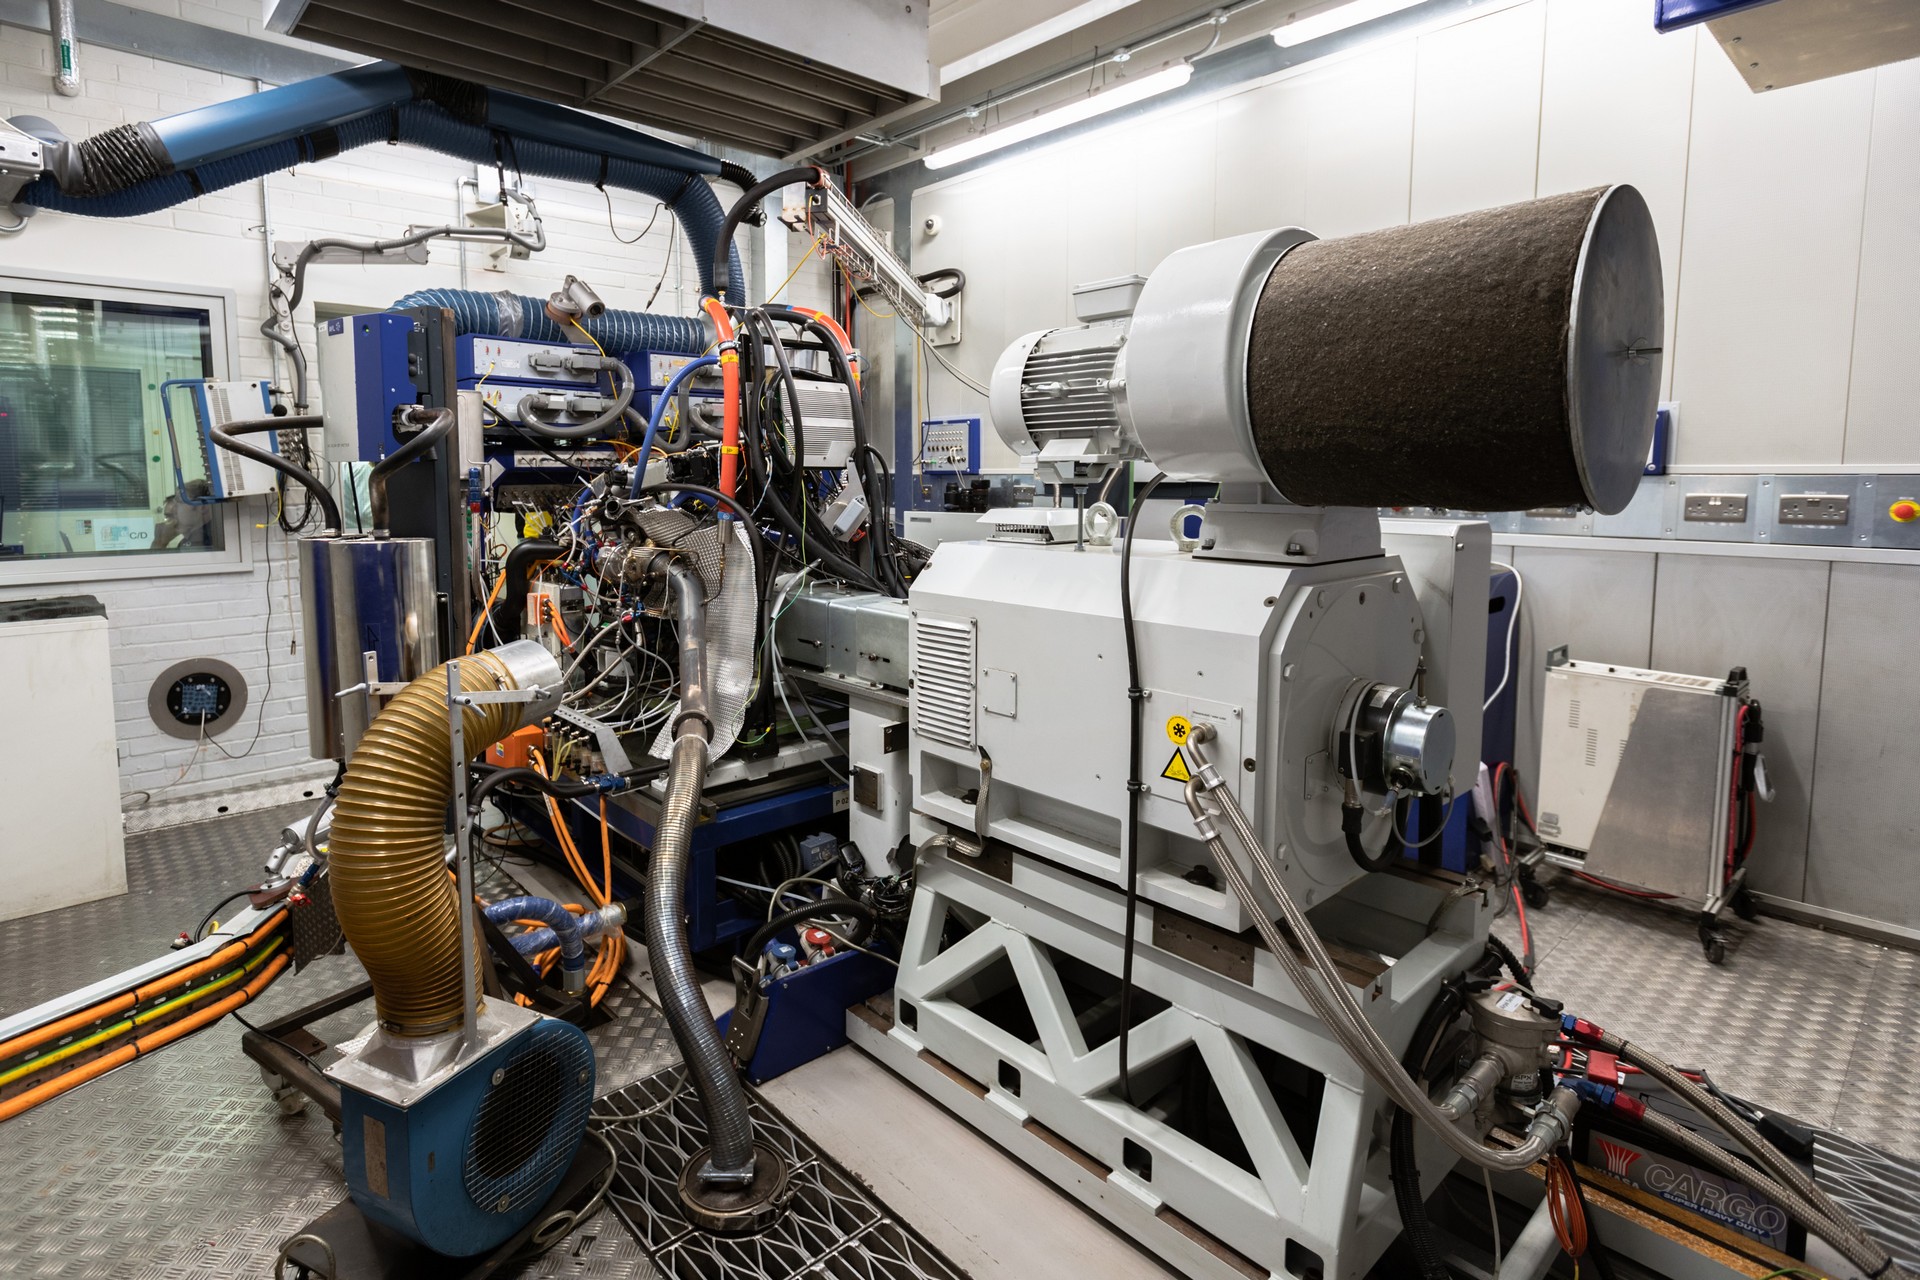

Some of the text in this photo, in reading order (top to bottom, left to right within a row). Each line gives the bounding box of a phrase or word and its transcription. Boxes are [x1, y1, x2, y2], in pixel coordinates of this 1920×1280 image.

[129, 531, 148, 540] C/D
[1644, 1163, 1787, 1235] CARGO
[1662, 1192, 1765, 1236] SUPER HEAVY DUTY
